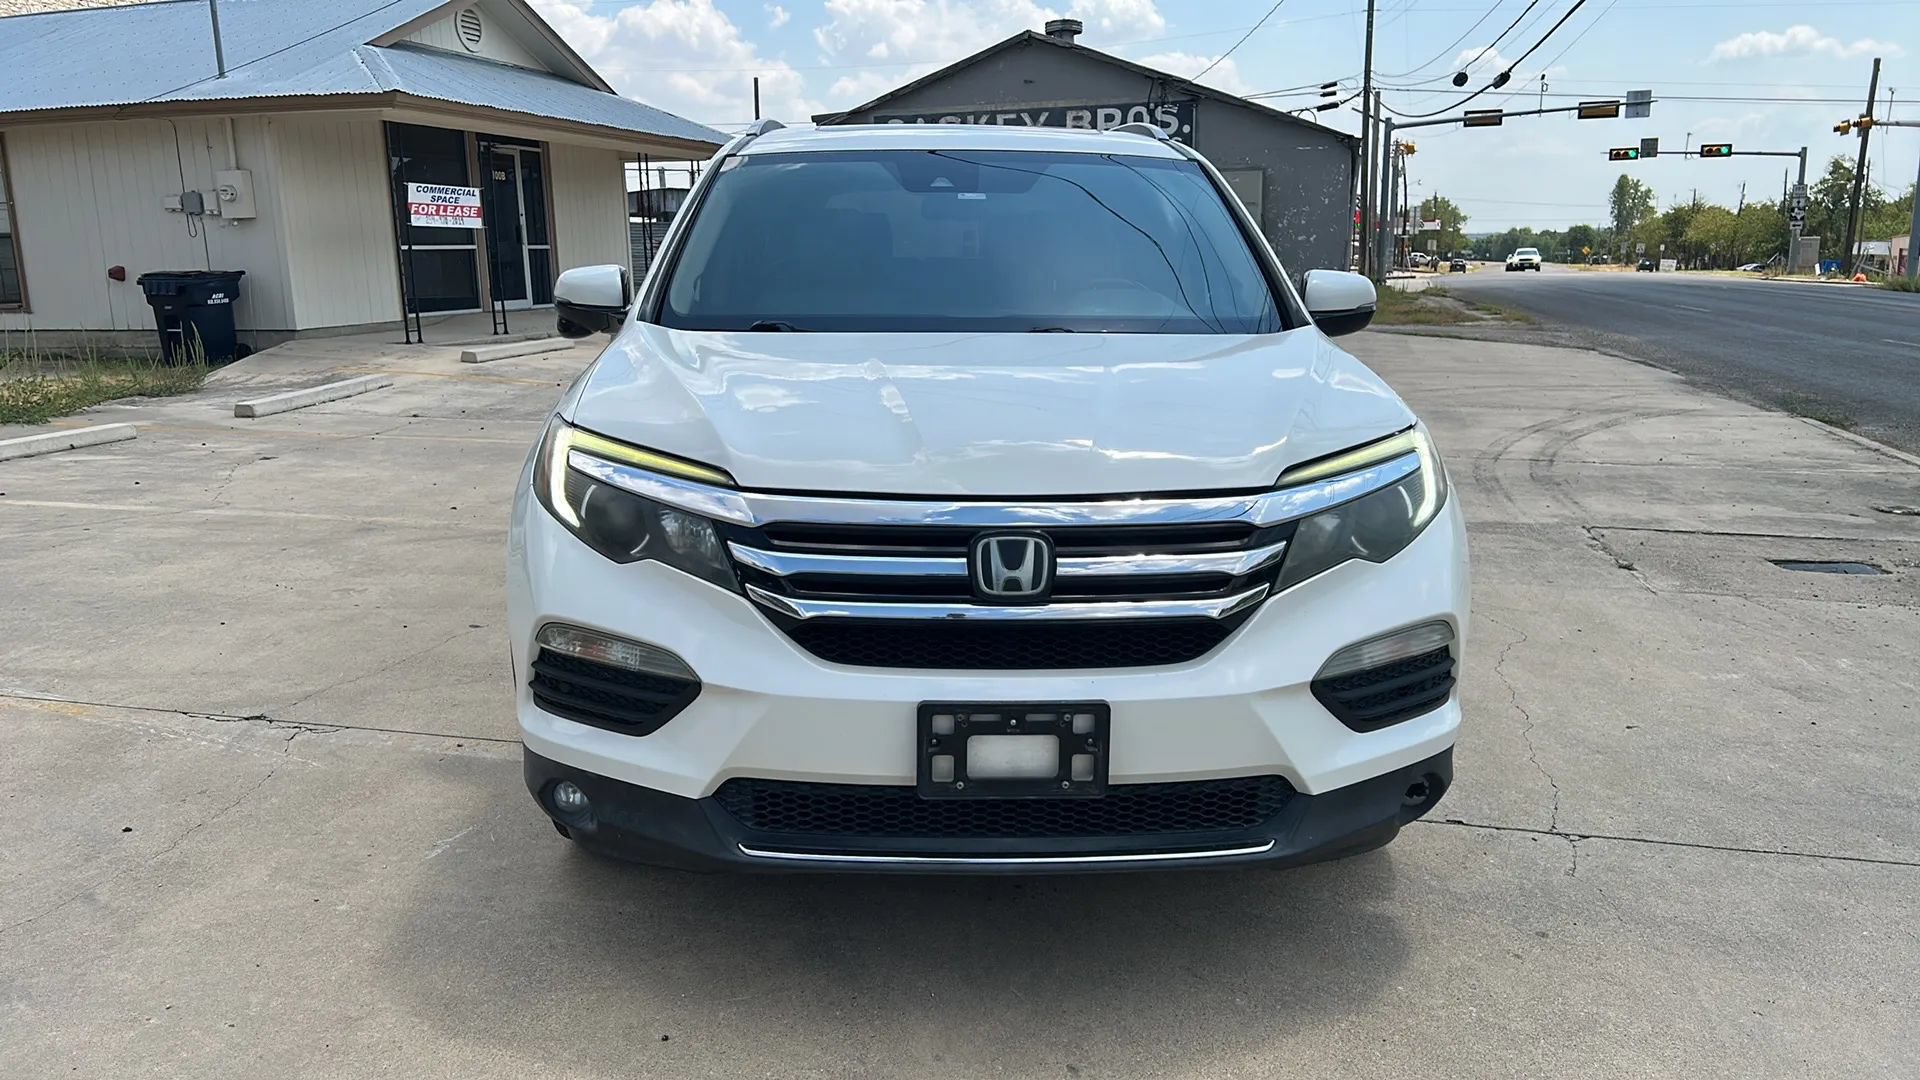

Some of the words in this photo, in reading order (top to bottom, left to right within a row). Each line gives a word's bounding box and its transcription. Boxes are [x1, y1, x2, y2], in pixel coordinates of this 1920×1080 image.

[416, 185, 477, 197] COMMERCIAL
[430, 194, 460, 204] SPACE
[411, 204, 437, 215] FOR
[439, 205, 478, 217] LEASE
